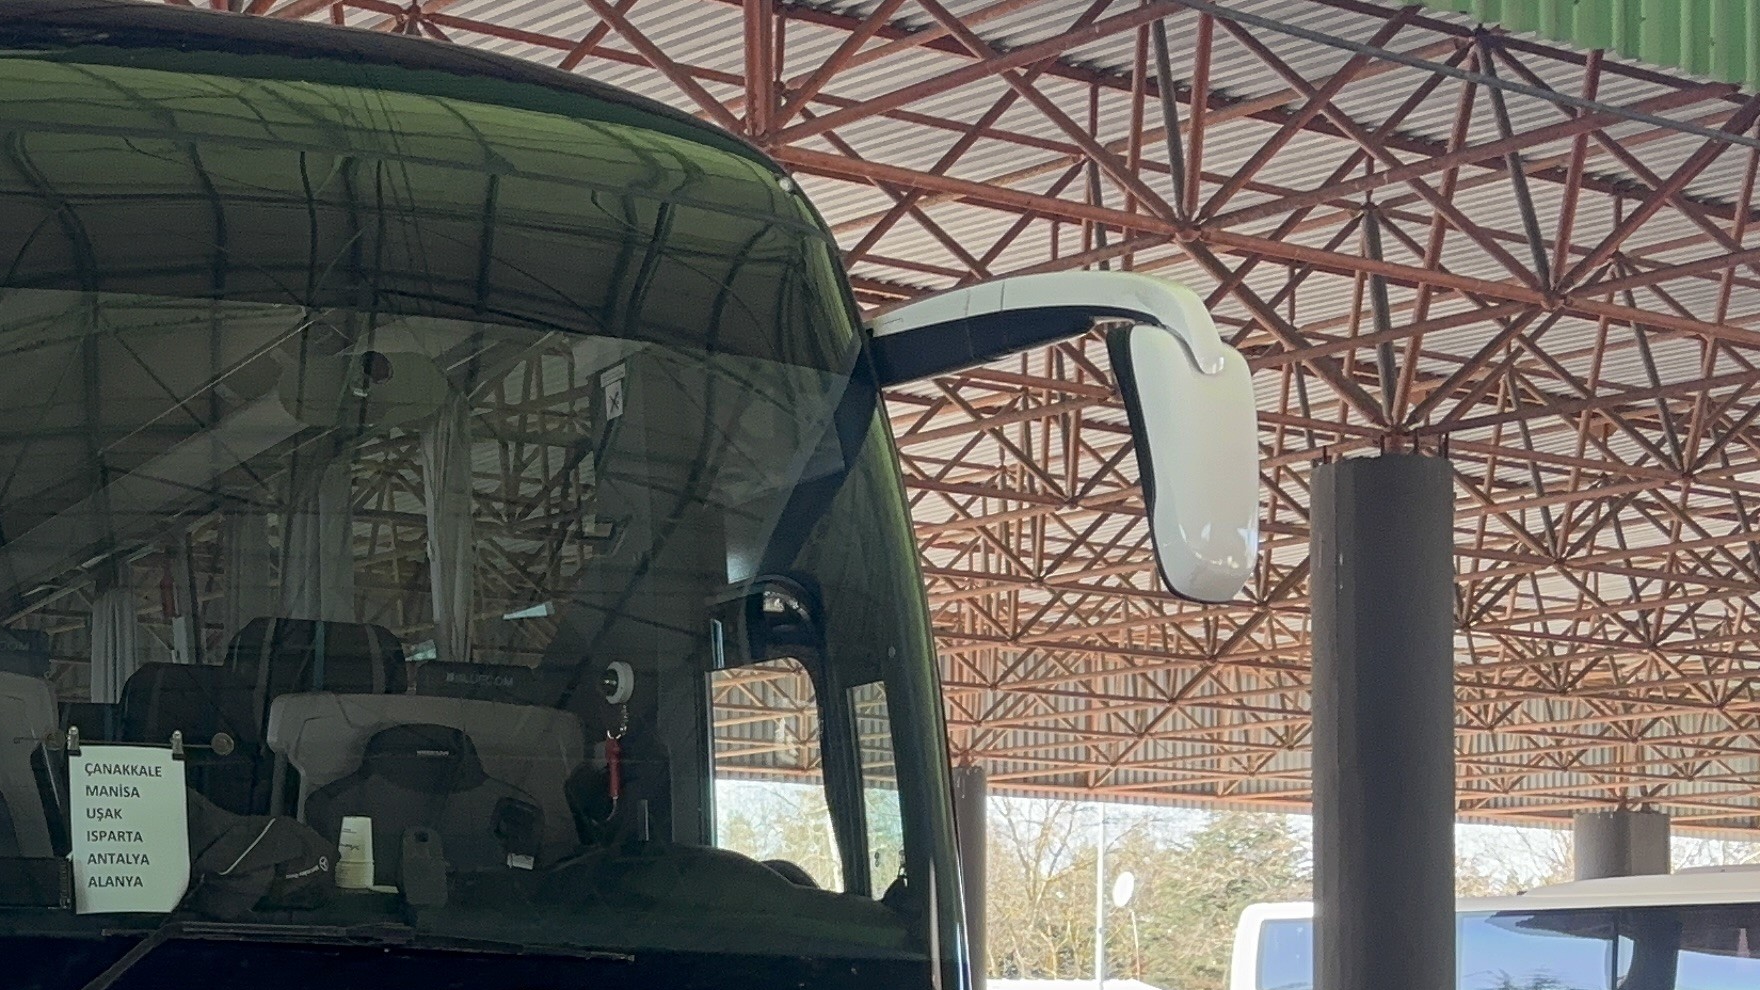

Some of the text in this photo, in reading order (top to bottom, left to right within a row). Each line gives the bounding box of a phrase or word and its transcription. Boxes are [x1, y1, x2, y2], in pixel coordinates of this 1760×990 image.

[84, 763, 162, 778] ÇANAKKALE
[85, 784, 141, 798] MANİSA
[86, 808, 123, 822] UŞAK
[86, 831, 144, 843] ISPARTA
[87, 853, 150, 865] ANTALYA
[87, 876, 144, 888] ALANYA
